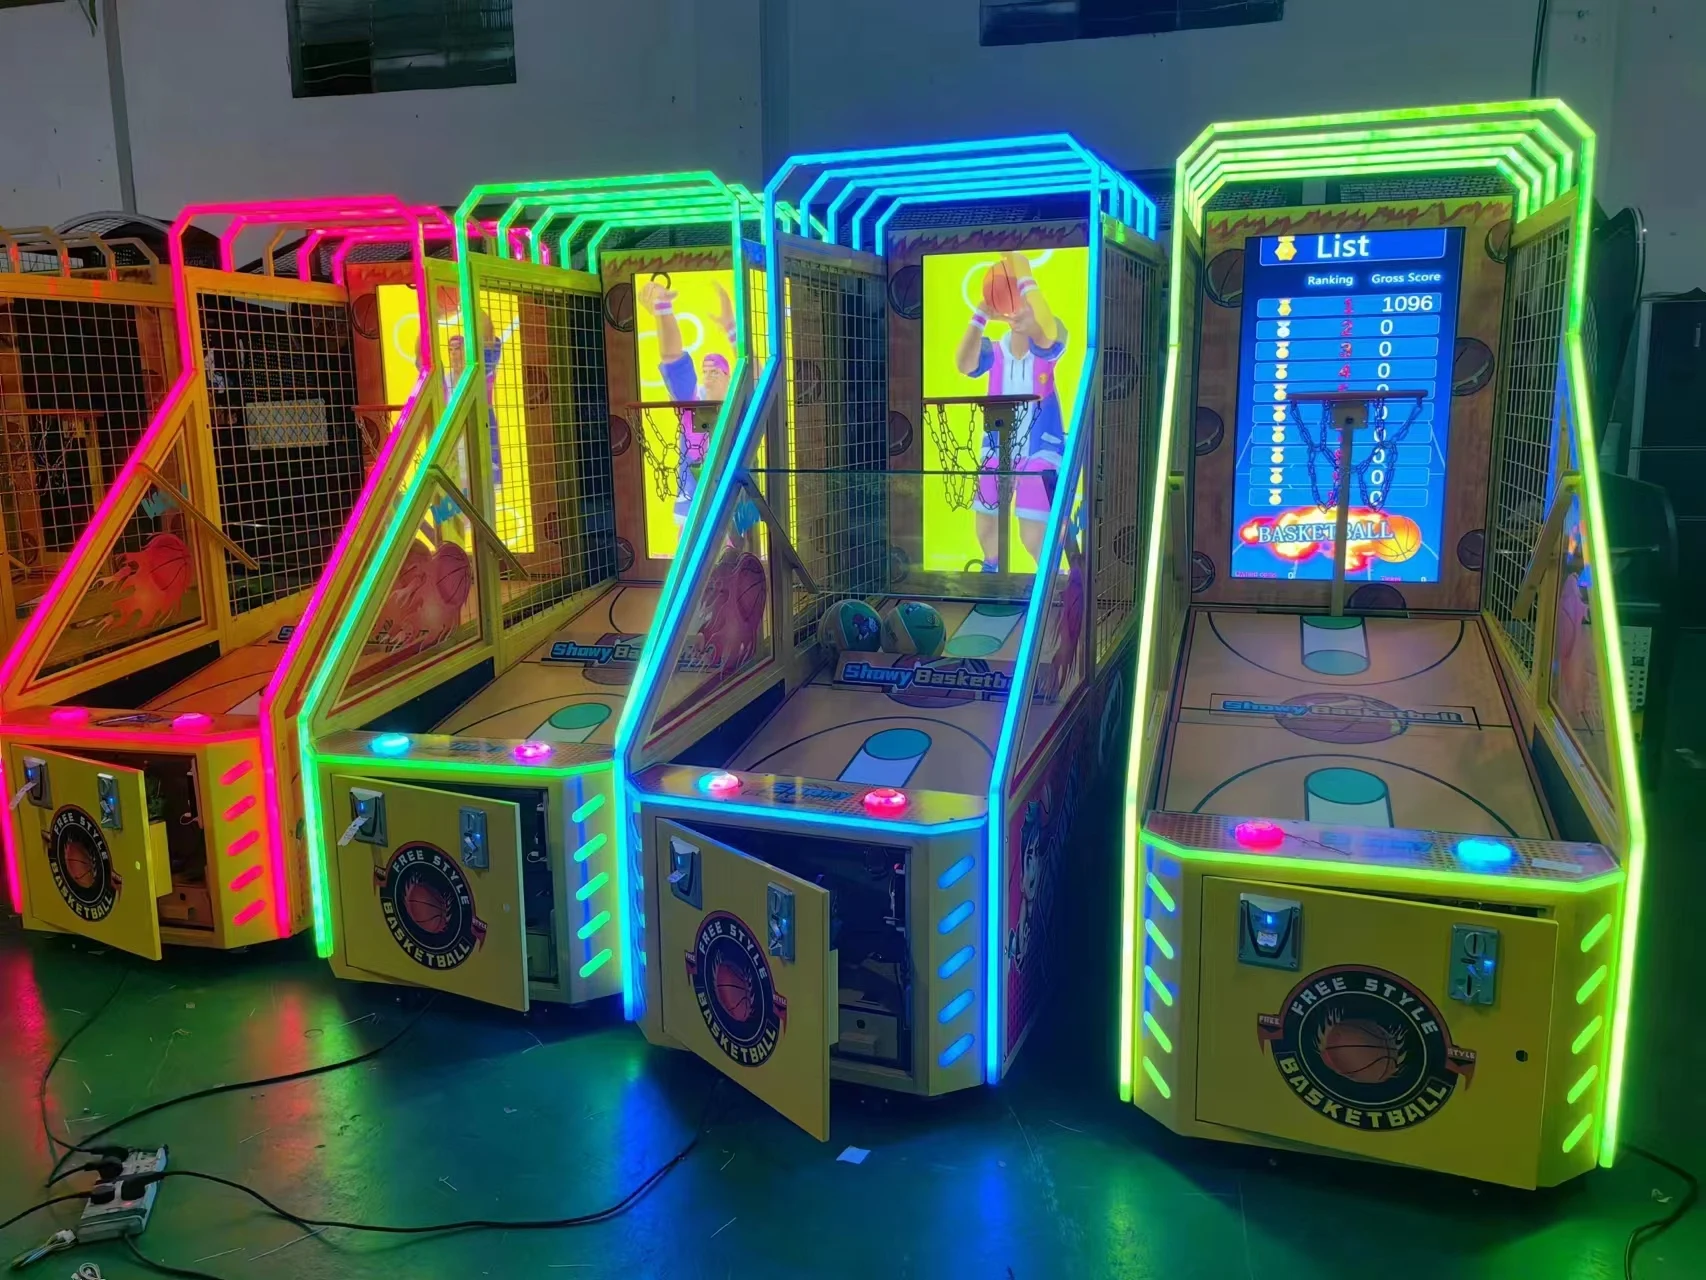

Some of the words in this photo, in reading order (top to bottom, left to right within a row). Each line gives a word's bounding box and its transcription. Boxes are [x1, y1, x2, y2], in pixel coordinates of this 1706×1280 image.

[1316, 233, 1370, 259] List
[1307, 274, 1354, 287] Ranking
[1371, 273, 1404, 285] Gross
[1408, 272, 1441, 283] Score
[1343, 298, 1354, 315] 1
[1382, 295, 1433, 313] 1096
[1340, 320, 1353, 337] 2
[1380, 319, 1393, 335] 0
[1339, 343, 1352, 358] 3
[1378, 341, 1392, 357] 0
[1338, 365, 1351, 379] 4
[1377, 363, 1390, 379] 0
[1371, 469, 1384, 485] 0
[551, 643, 613, 663] Showy
[843, 663, 914, 687] Showy
[915, 668, 1013, 690] Basketb
[1222, 700, 1309, 716] Showy
[1310, 705, 1463, 723] Basketball
[54, 812, 75, 835] FREE
[80, 816, 108, 860] STYLE
[392, 850, 425, 873] FREE
[432, 855, 470, 905] STYLE
[50, 862, 113, 919] BASKETBALL
[383, 902, 471, 968] BASKETBALL
[700, 921, 723, 955] FREE
[730, 924, 767, 979] STYLE
[1290, 976, 1347, 1016] FREE
[1364, 978, 1438, 1034] STYLE
[697, 991, 776, 1063] BASKETBALL
[1258, 1015, 1280, 1025] FREE
[1279, 1057, 1448, 1129] BASKETBALL
